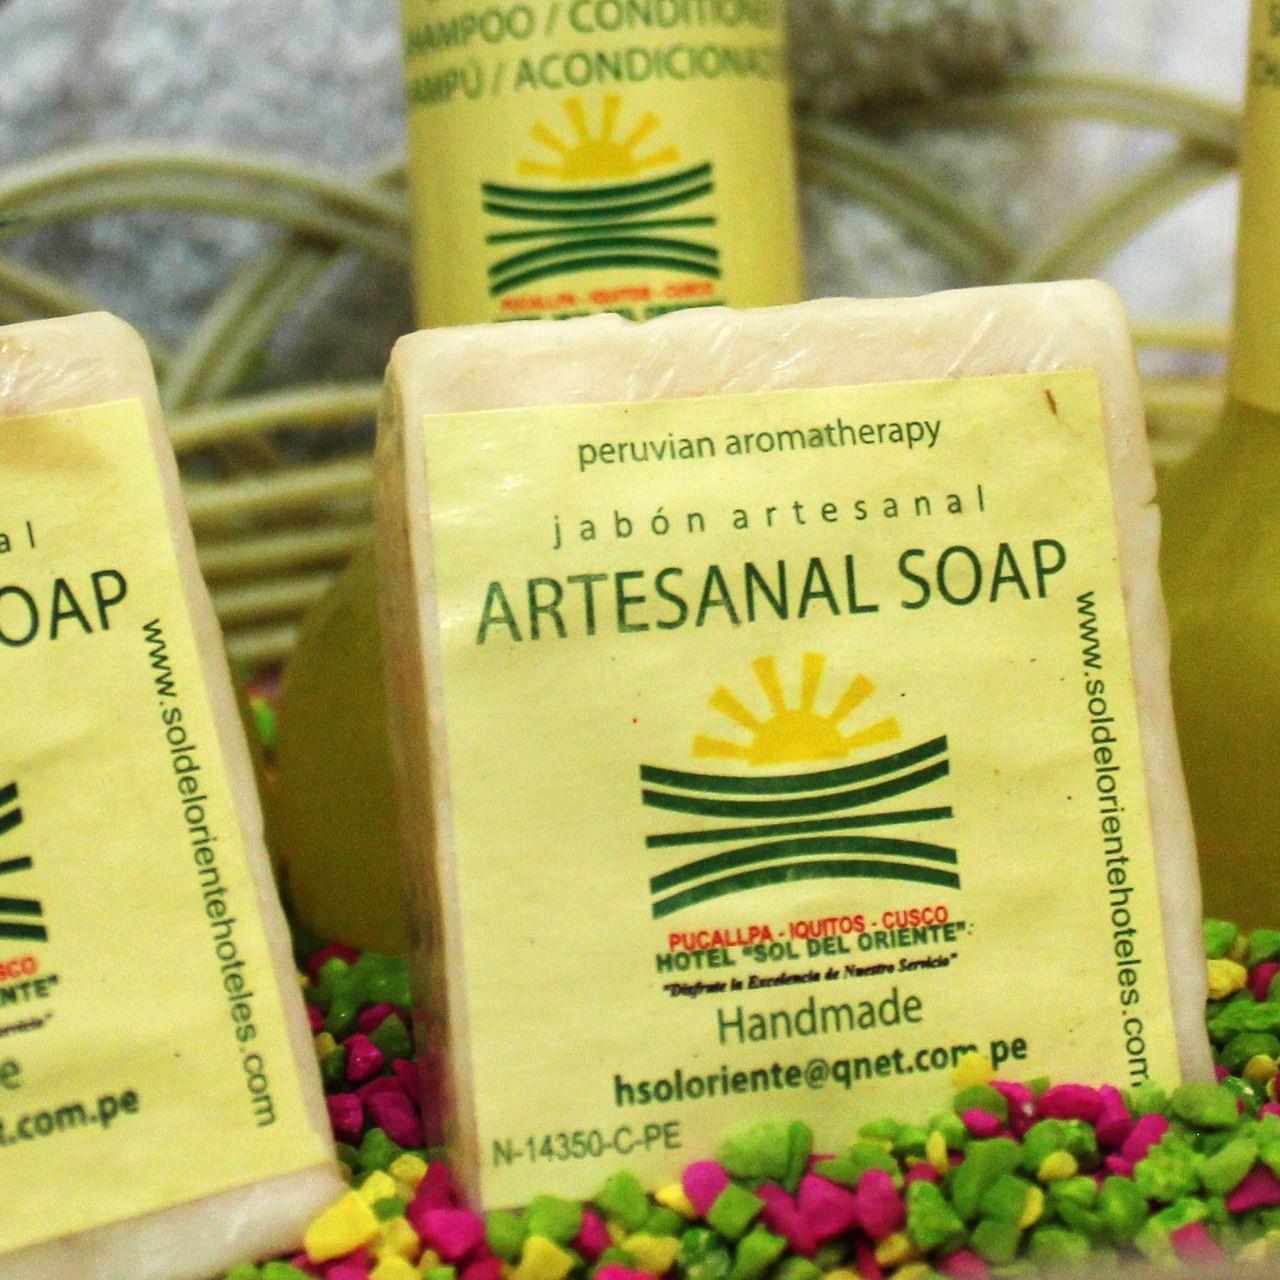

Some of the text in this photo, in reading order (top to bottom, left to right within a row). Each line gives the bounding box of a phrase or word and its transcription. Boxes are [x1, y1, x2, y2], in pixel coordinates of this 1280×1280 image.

[546, 0, 561, 37] /
[491, 61, 505, 96] /
[578, 413, 943, 473] peruvian aromatherapy
[551, 484, 987, 549] jabón artesanal
[476, 537, 1068, 646] ARTESANAL SOAP
[141, 618, 278, 1128] www.soldelorientehoteles.com
[656, 921, 966, 973] HOTEL "SOL DEL ORIENTE"
[669, 924, 773, 952] PUCALLPA
[789, 915, 865, 940] IQUITOS
[882, 905, 949, 929] CUSCO
[718, 987, 923, 1045] Handmade
[491, 1122, 681, 1168] N-14350-C-PE
